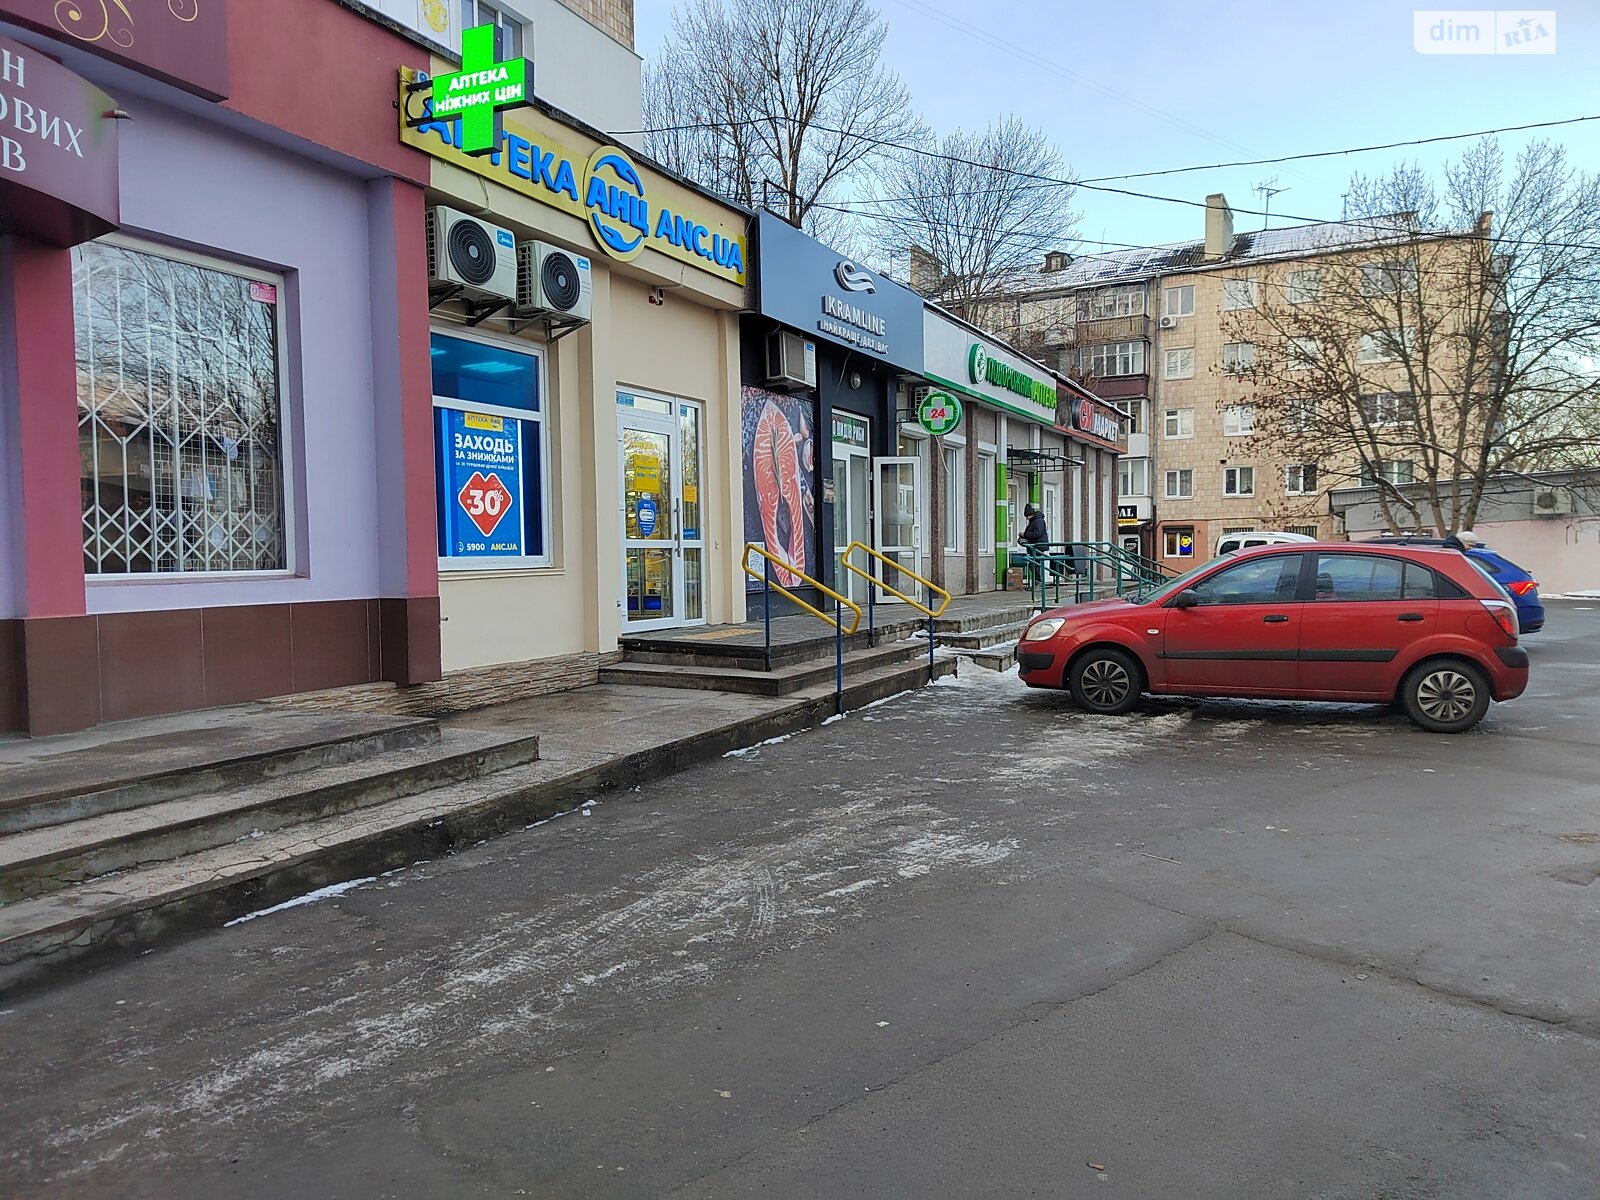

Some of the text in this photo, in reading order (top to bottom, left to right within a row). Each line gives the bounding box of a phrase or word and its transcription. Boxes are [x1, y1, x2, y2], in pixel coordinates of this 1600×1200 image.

[448, 66, 509, 92] АПТЕКА
[494, 82, 522, 103] ЦІН
[586, 176, 649, 237] АНЦ
[655, 209, 745, 274] ANC.UA
[824, 294, 886, 336] KRAMLINE
[931, 408, 946, 419] 24
[454, 433, 514, 455] ЗАХОДЬ
[466, 452, 515, 464] ЗНИЖКАМИ
[1118, 508, 1134, 517] AL
[466, 543, 518, 551] 5900 ANC.UA
